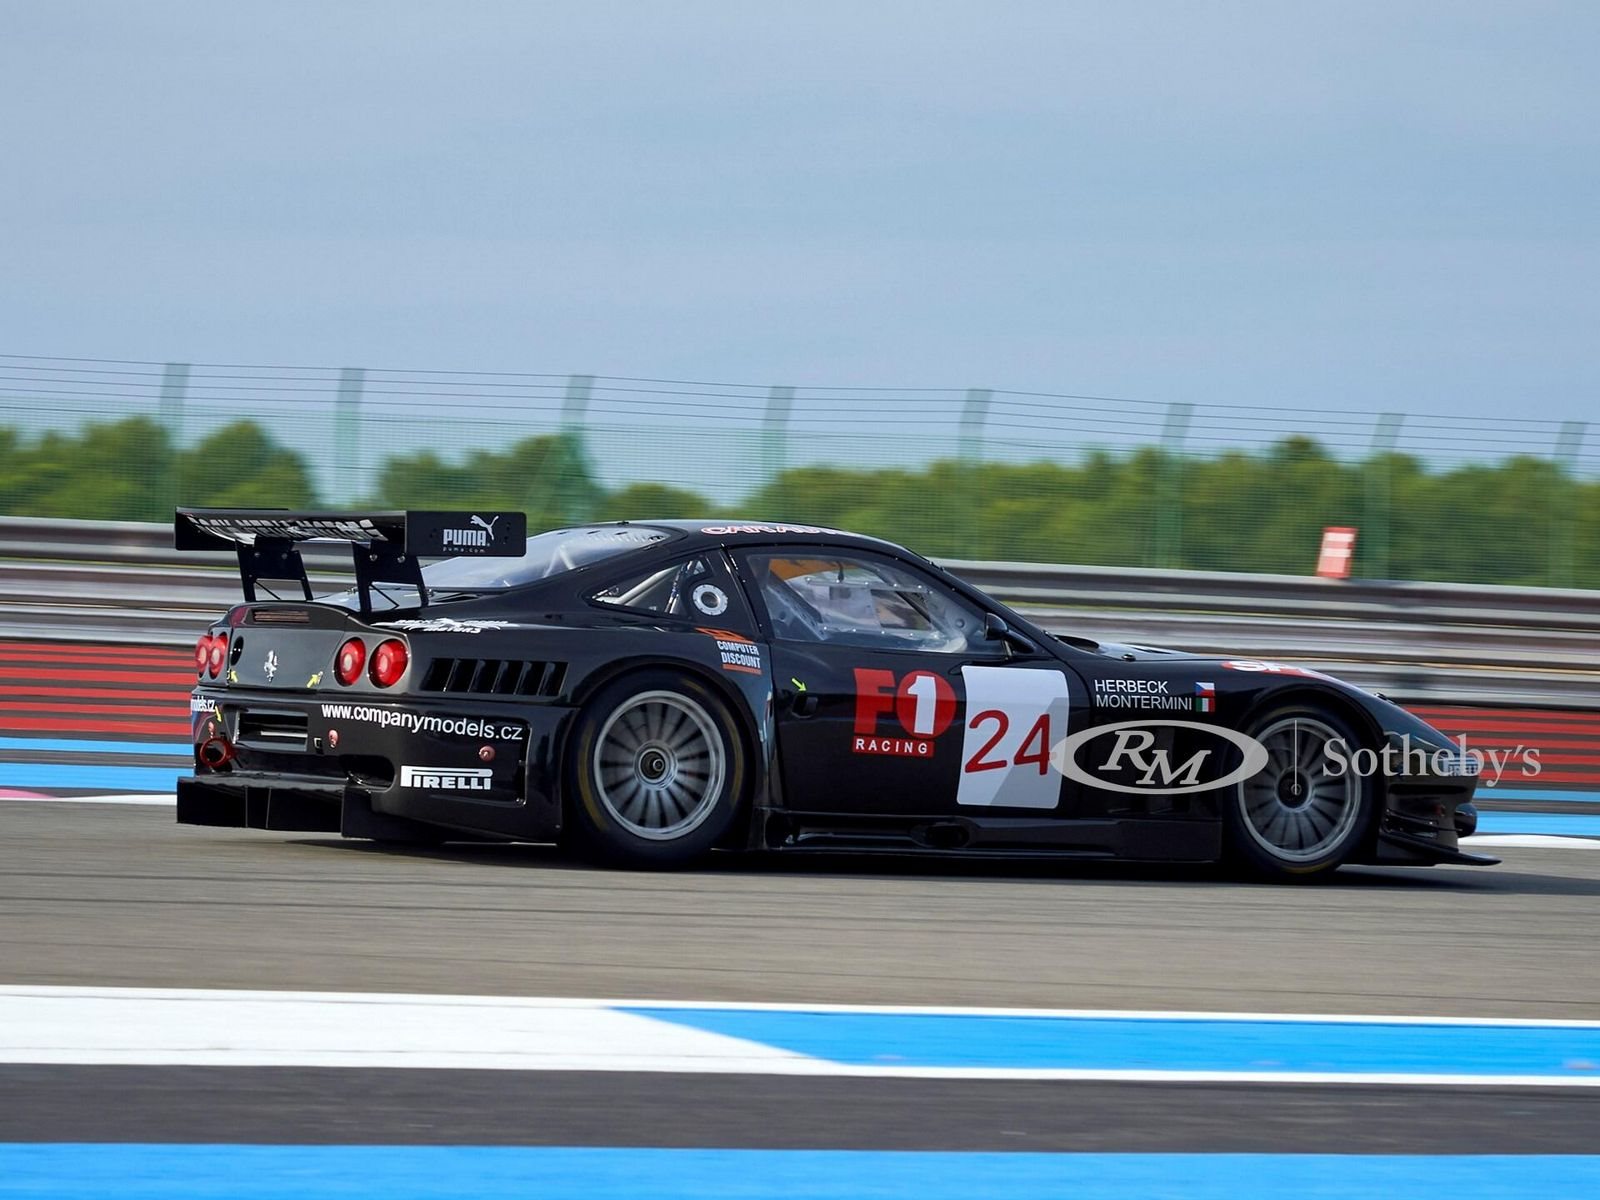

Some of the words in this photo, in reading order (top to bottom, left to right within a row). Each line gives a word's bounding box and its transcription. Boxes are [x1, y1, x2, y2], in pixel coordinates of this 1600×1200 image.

[443, 529, 487, 546] PUMA
[717, 641, 760, 656] COMPUTER
[720, 652, 761, 669] DISCOUNT
[1094, 679, 1169, 695] HERBECK
[1095, 694, 1193, 711] MONTERMINI
[321, 703, 523, 740] www.companymodels.cz
[855, 739, 928, 754] RACING
[964, 709, 1056, 776] 24
[400, 765, 494, 790] PIRELLI
